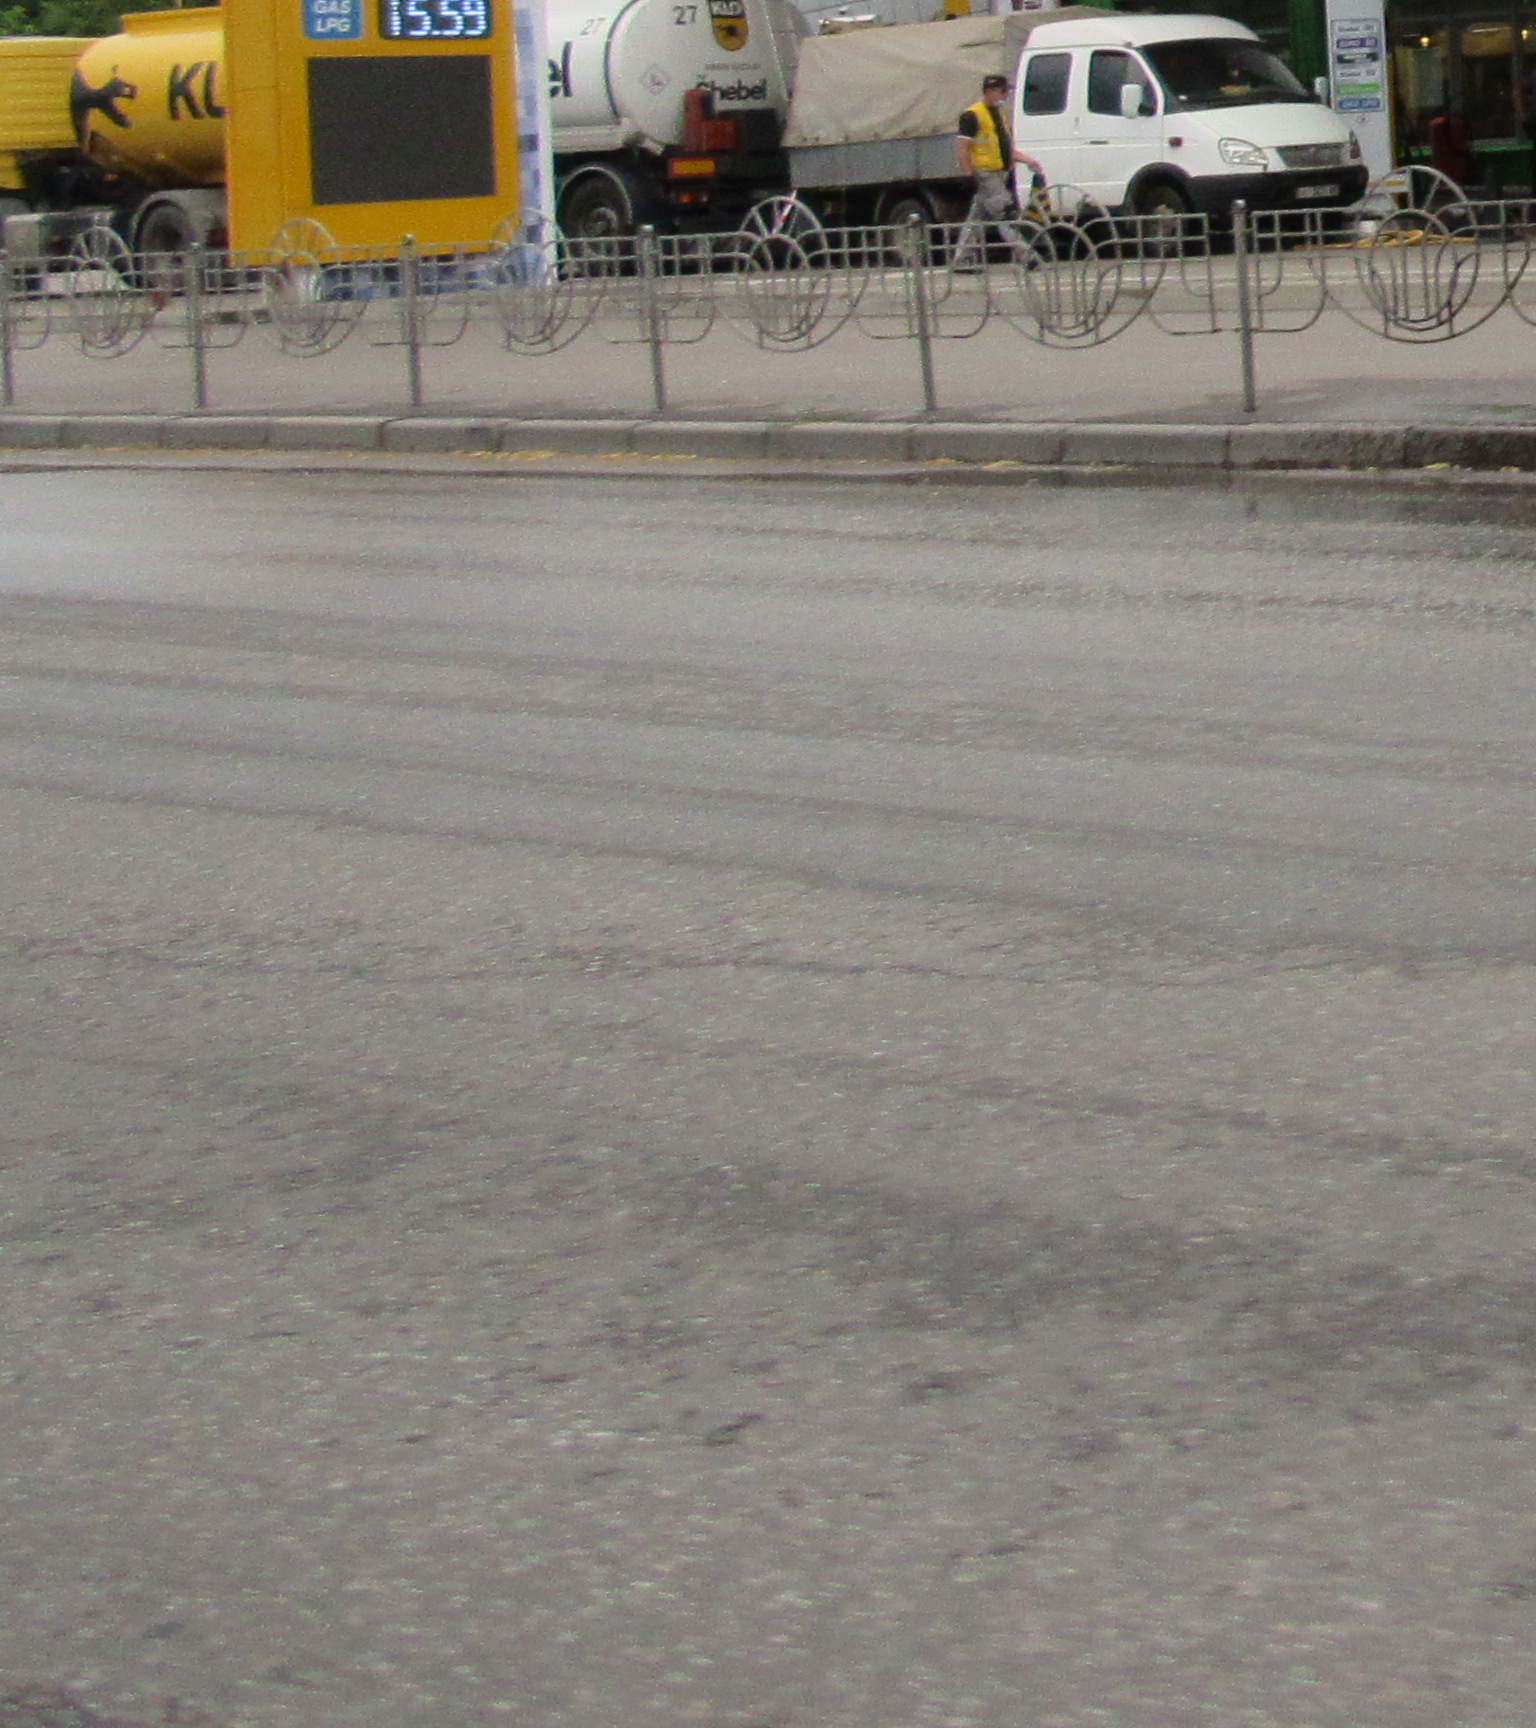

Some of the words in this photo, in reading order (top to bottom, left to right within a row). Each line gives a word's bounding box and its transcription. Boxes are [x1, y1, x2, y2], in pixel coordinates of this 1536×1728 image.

[313, 0, 352, 14] GAS
[673, 5, 698, 25] 27
[580, 18, 607, 36] 27
[169, 61, 228, 122] KL
